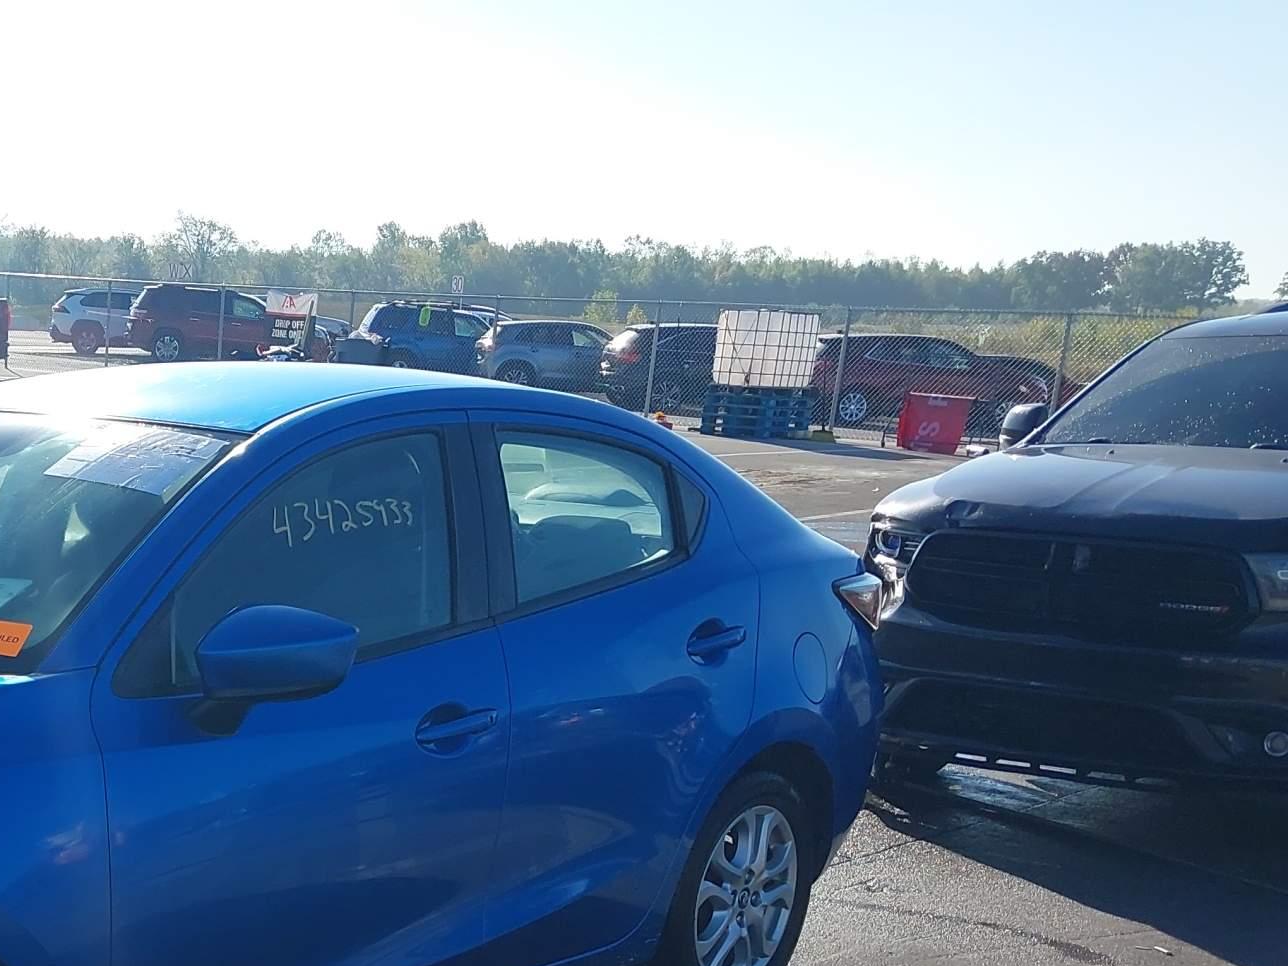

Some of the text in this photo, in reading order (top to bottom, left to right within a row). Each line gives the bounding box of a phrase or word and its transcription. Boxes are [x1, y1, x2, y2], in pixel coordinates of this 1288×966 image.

[183, 264, 192, 278] X
[453, 276, 462, 292] 30
[275, 319, 304, 330] DROP OFF
[273, 498, 412, 547] 43425933
